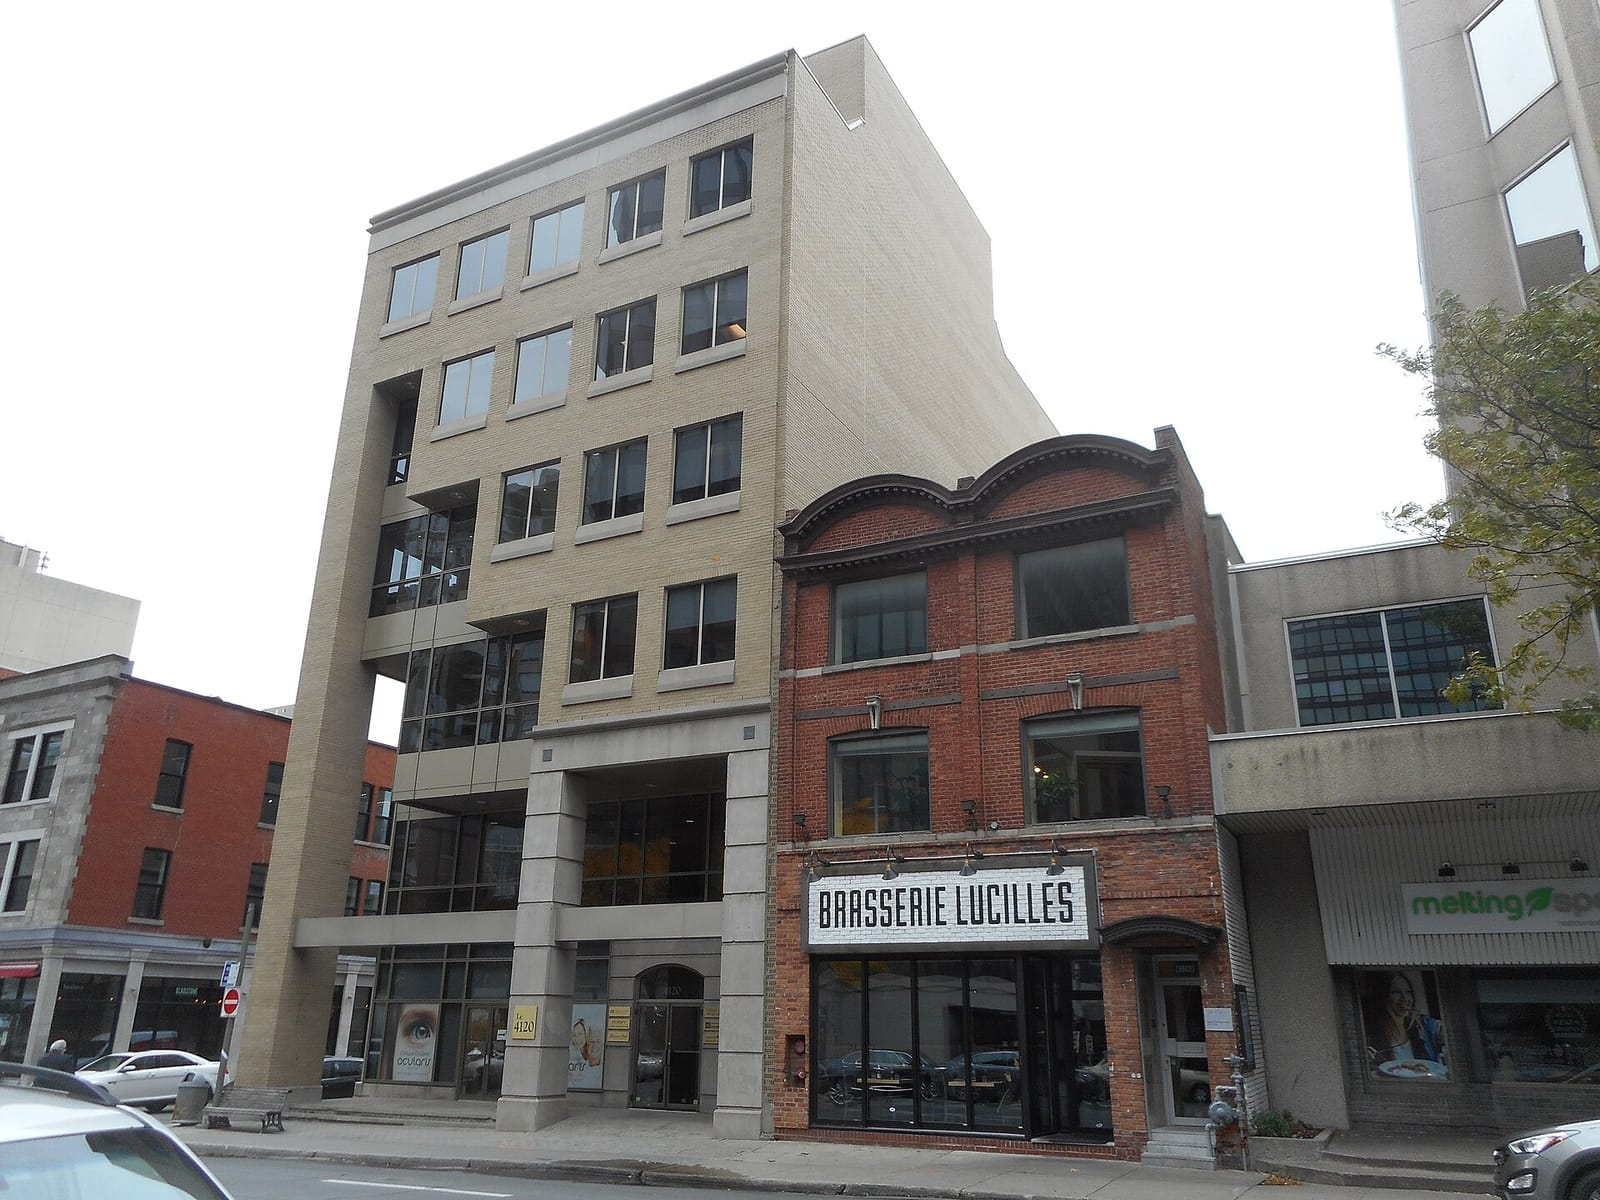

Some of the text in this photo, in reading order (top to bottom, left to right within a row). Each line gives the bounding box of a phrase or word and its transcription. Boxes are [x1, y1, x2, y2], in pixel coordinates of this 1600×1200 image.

[819, 882, 1074, 929] BRASSERIE LUCILLES
[1412, 891, 1524, 921] melting
[513, 1020, 535, 1033] 4120
[397, 1057, 432, 1066] ocularis
